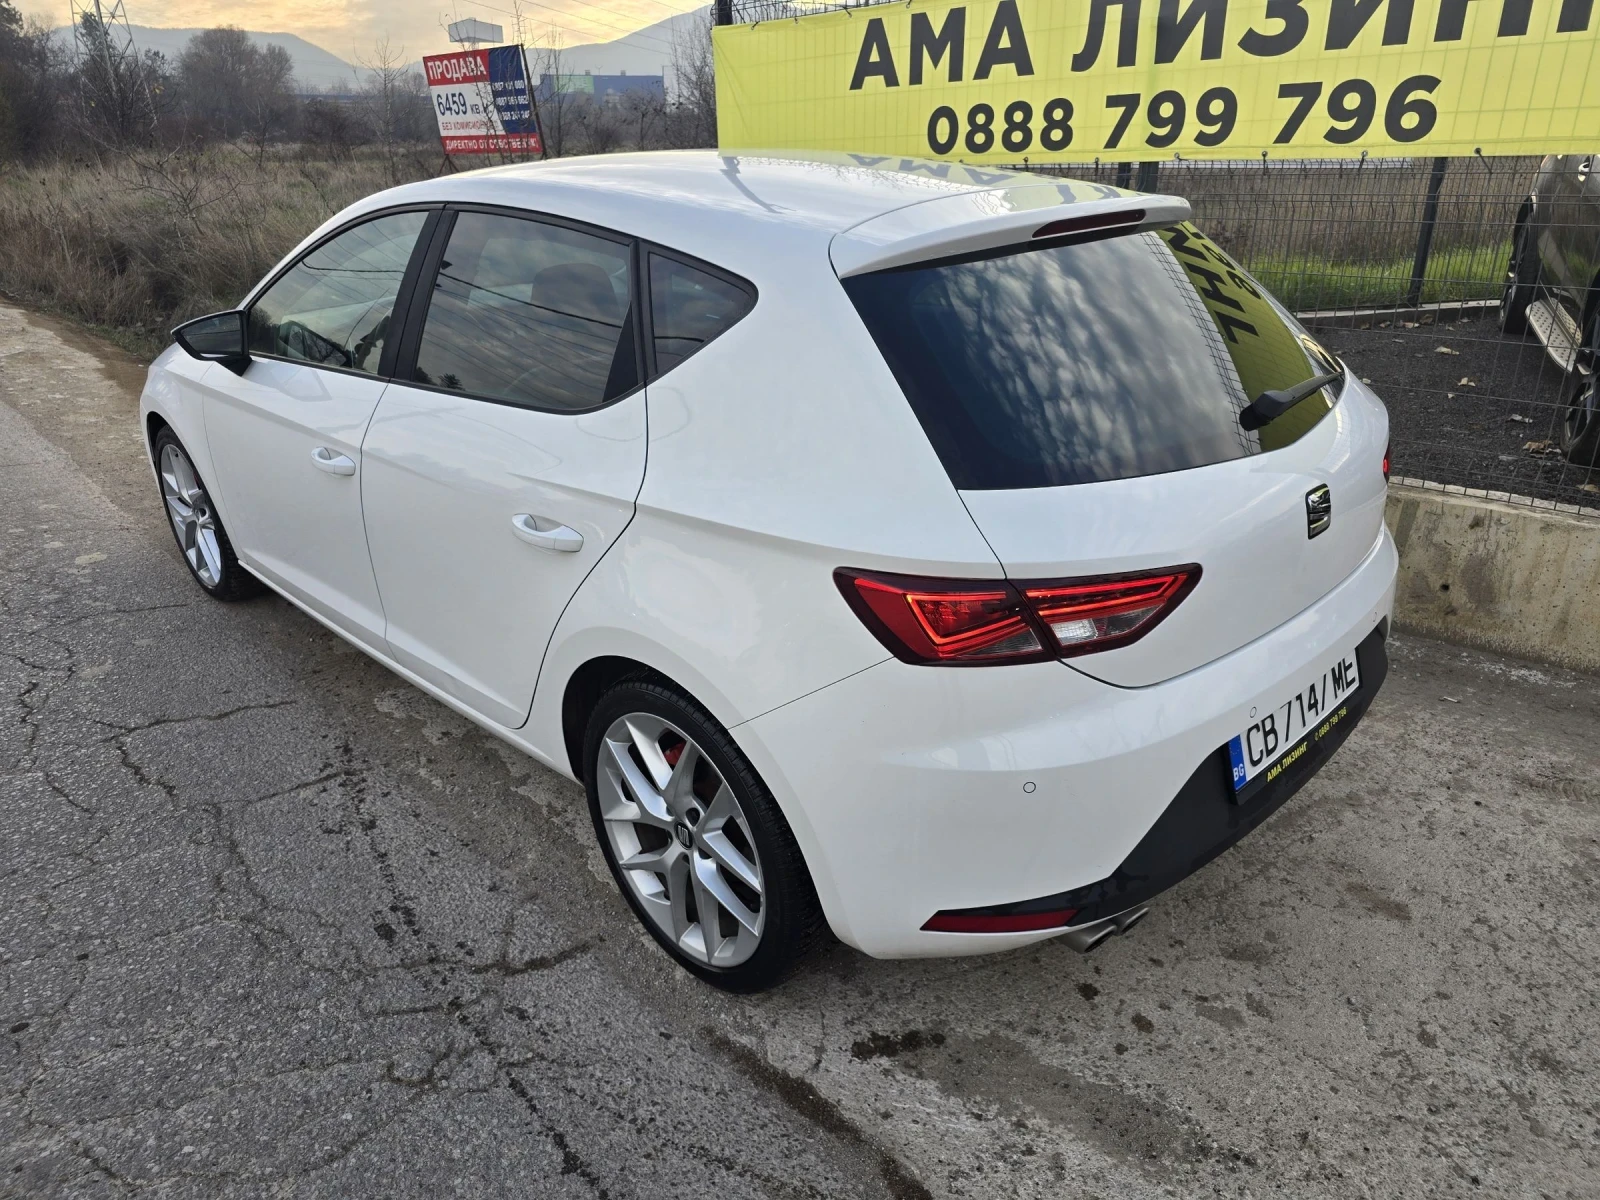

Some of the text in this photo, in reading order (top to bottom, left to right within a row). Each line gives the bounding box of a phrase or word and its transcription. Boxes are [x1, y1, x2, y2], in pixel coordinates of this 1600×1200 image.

[849, 0, 1035, 90] АМА
[428, 56, 486, 81] ПРОДАВА
[437, 92, 467, 116] 6459
[927, 75, 1441, 155] 0888 799 796
[442, 121, 452, 130] БЕЗ
[446, 139, 478, 150] ДИРЕКТНО
[1233, 765, 1245, 781] BG
[1267, 764, 1282, 782] АМА
[1282, 741, 1308, 769] ЛИЗИНГ
